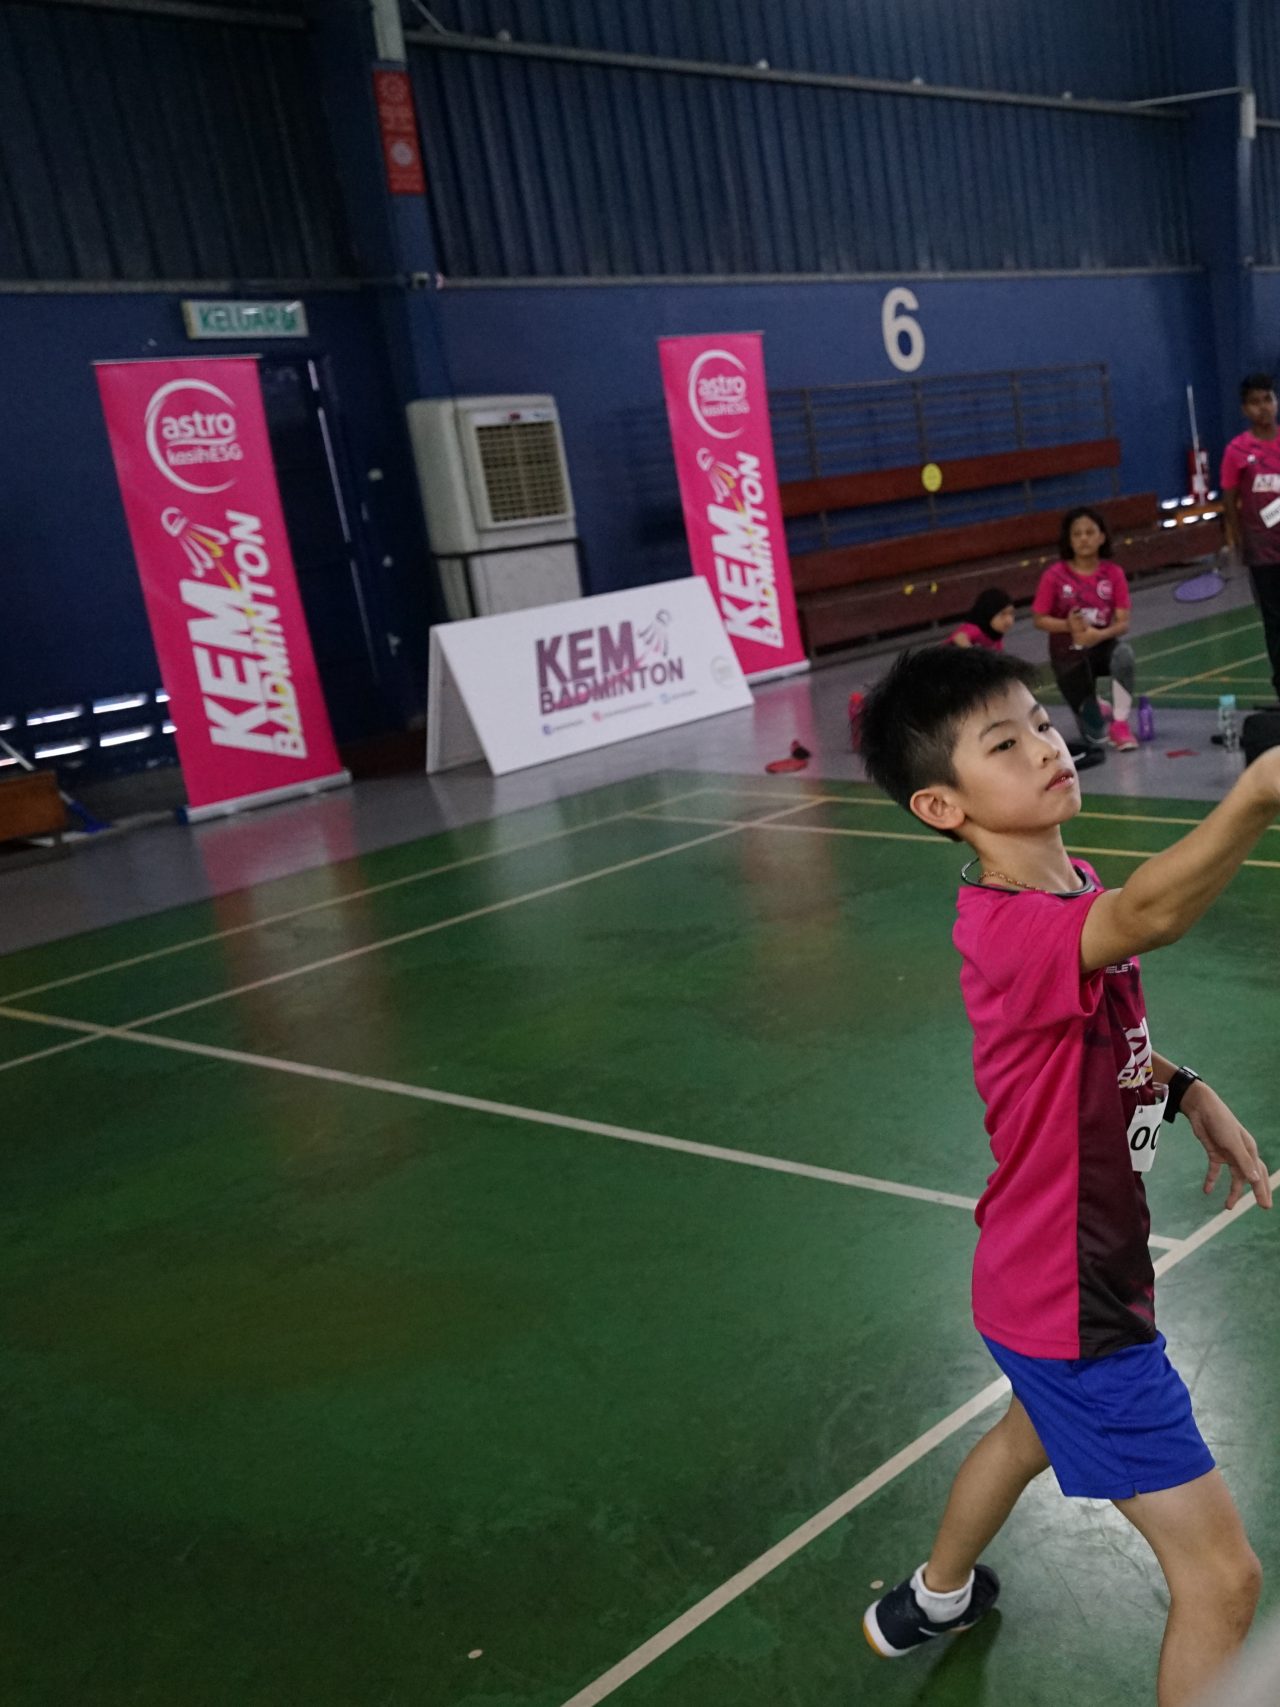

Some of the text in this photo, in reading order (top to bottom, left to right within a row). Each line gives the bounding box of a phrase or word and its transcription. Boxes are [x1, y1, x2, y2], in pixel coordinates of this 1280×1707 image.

[881, 286, 926, 373] 6
[161, 410, 236, 440] astro
[707, 503, 763, 643] KEM
[179, 578, 277, 754] KEM
[225, 509, 308, 759] BADMINTON
[535, 620, 637, 690] KEM
[540, 656, 685, 717] BADMINTON
